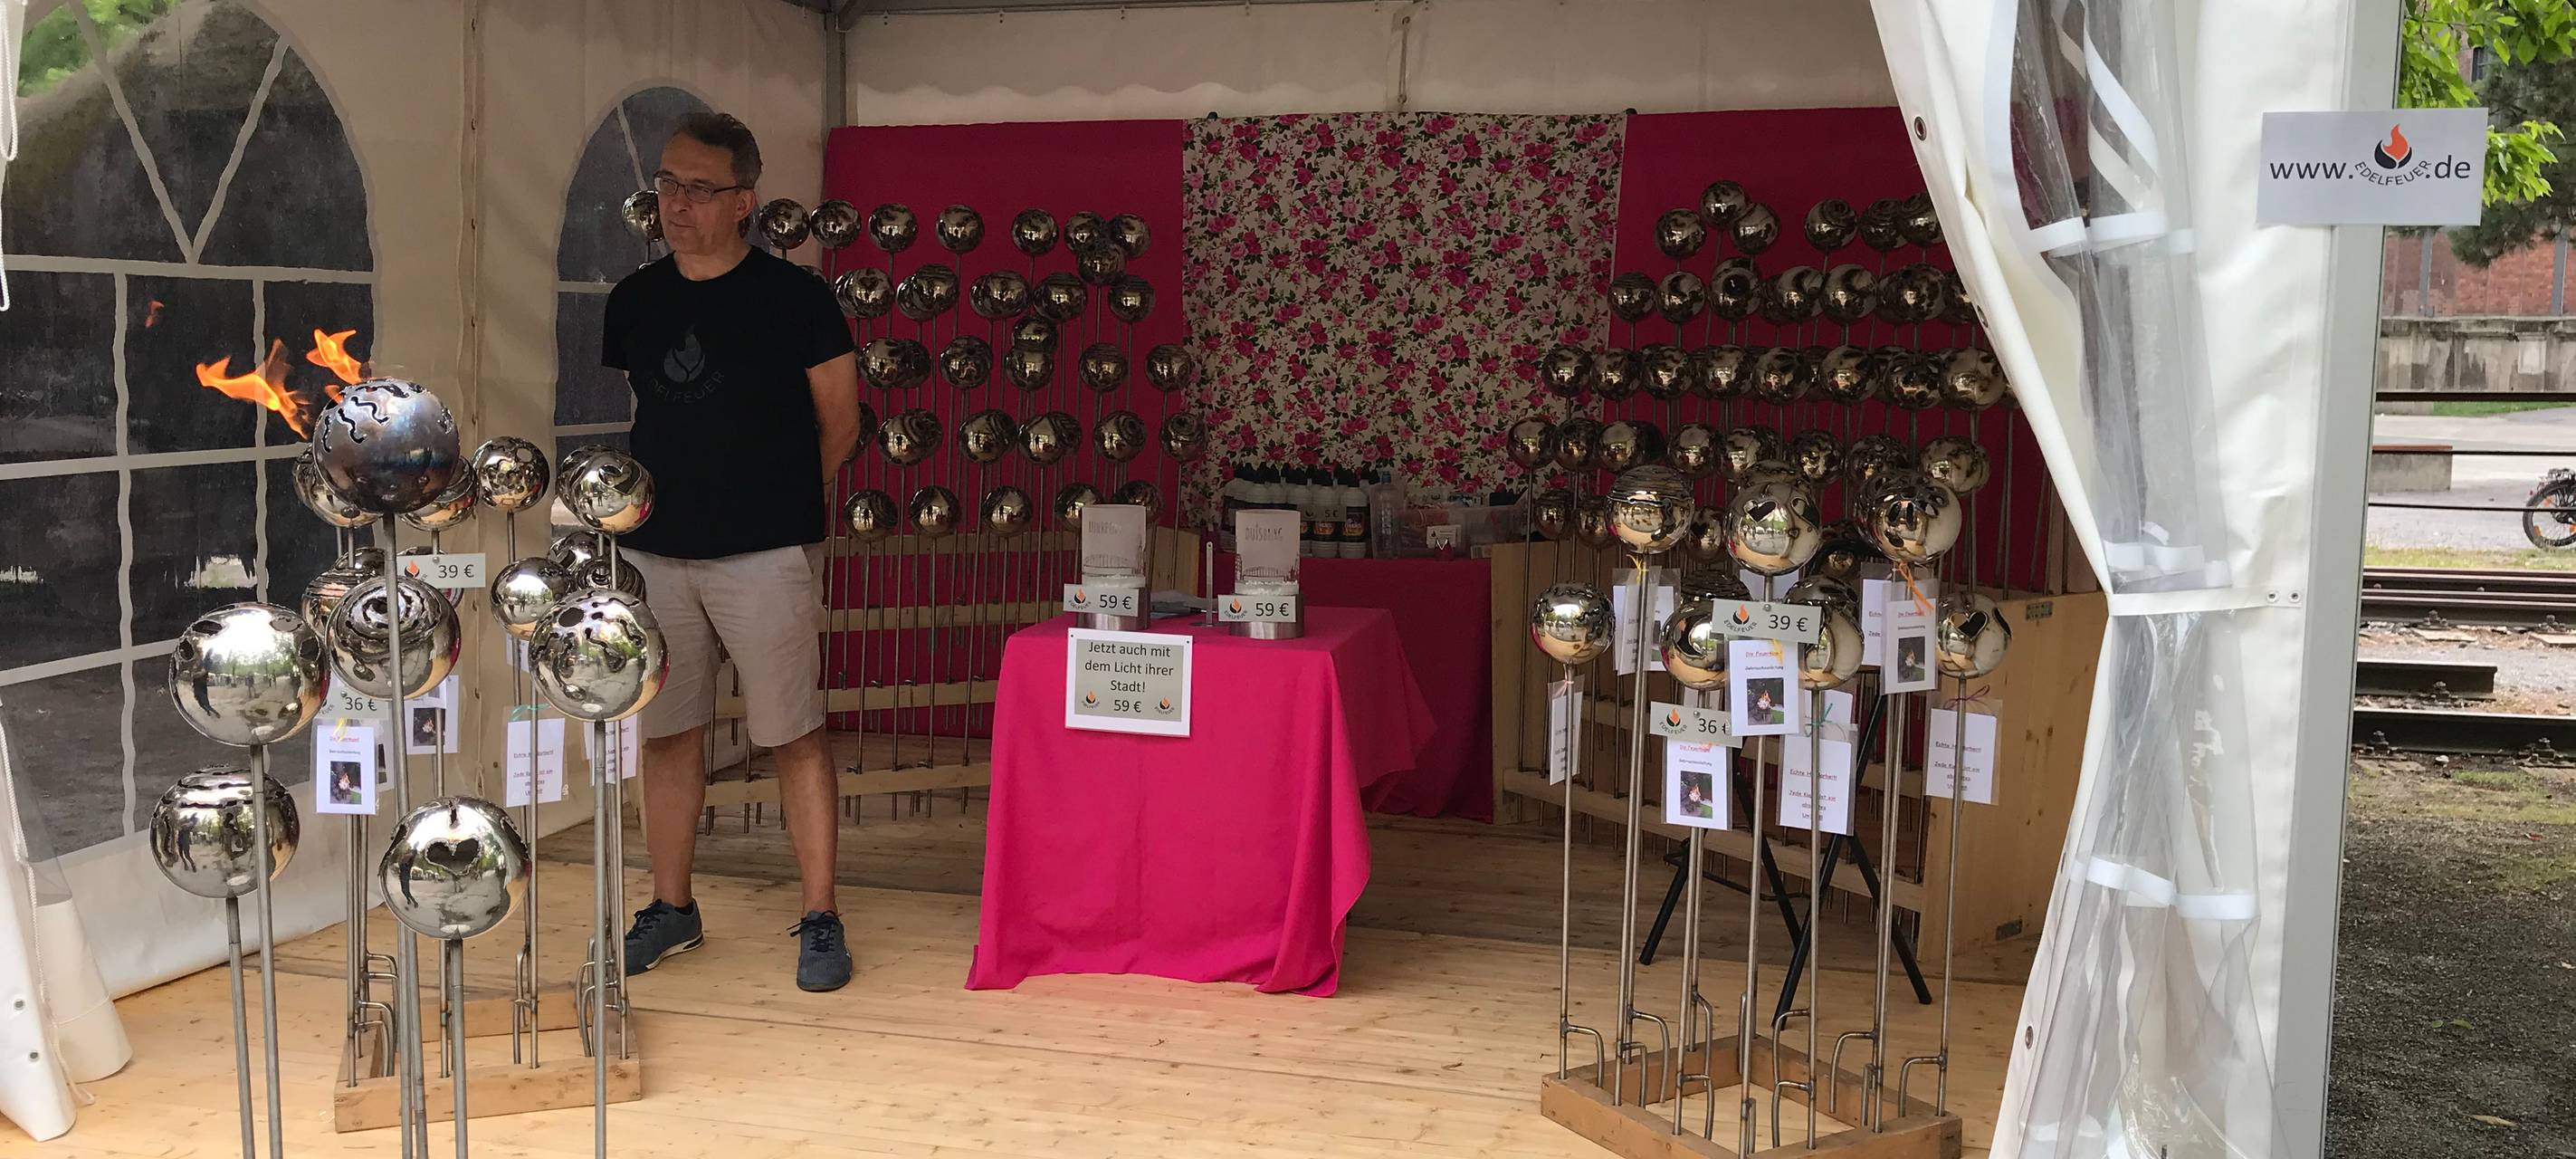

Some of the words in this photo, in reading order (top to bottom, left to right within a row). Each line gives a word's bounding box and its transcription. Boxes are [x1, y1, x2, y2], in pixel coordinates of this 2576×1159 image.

[438, 564, 458, 579] 39
[463, 564, 474, 578] €
[1099, 594, 1118, 609] 59
[1121, 596, 1132, 610] €
[1255, 602, 1274, 617] 59
[1279, 602, 1290, 617] €
[1723, 618, 1758, 633] EDELFEUER
[1768, 614, 1791, 630] 39
[1796, 617, 1808, 632] €
[1089, 641, 1116, 654] Jetzt
[1119, 644, 1147, 656] auch
[1150, 646, 1171, 657] mit
[1084, 659, 1111, 672] dem
[1114, 661, 1142, 675] Licht
[1145, 663, 1174, 676] ihrer
[1110, 680, 1146, 693] Stadt!
[344, 696, 364, 711] 36
[367, 698, 377, 712] €
[1113, 699, 1130, 712] 59
[1133, 701, 1142, 714] €
[1697, 717, 1717, 734] 36
